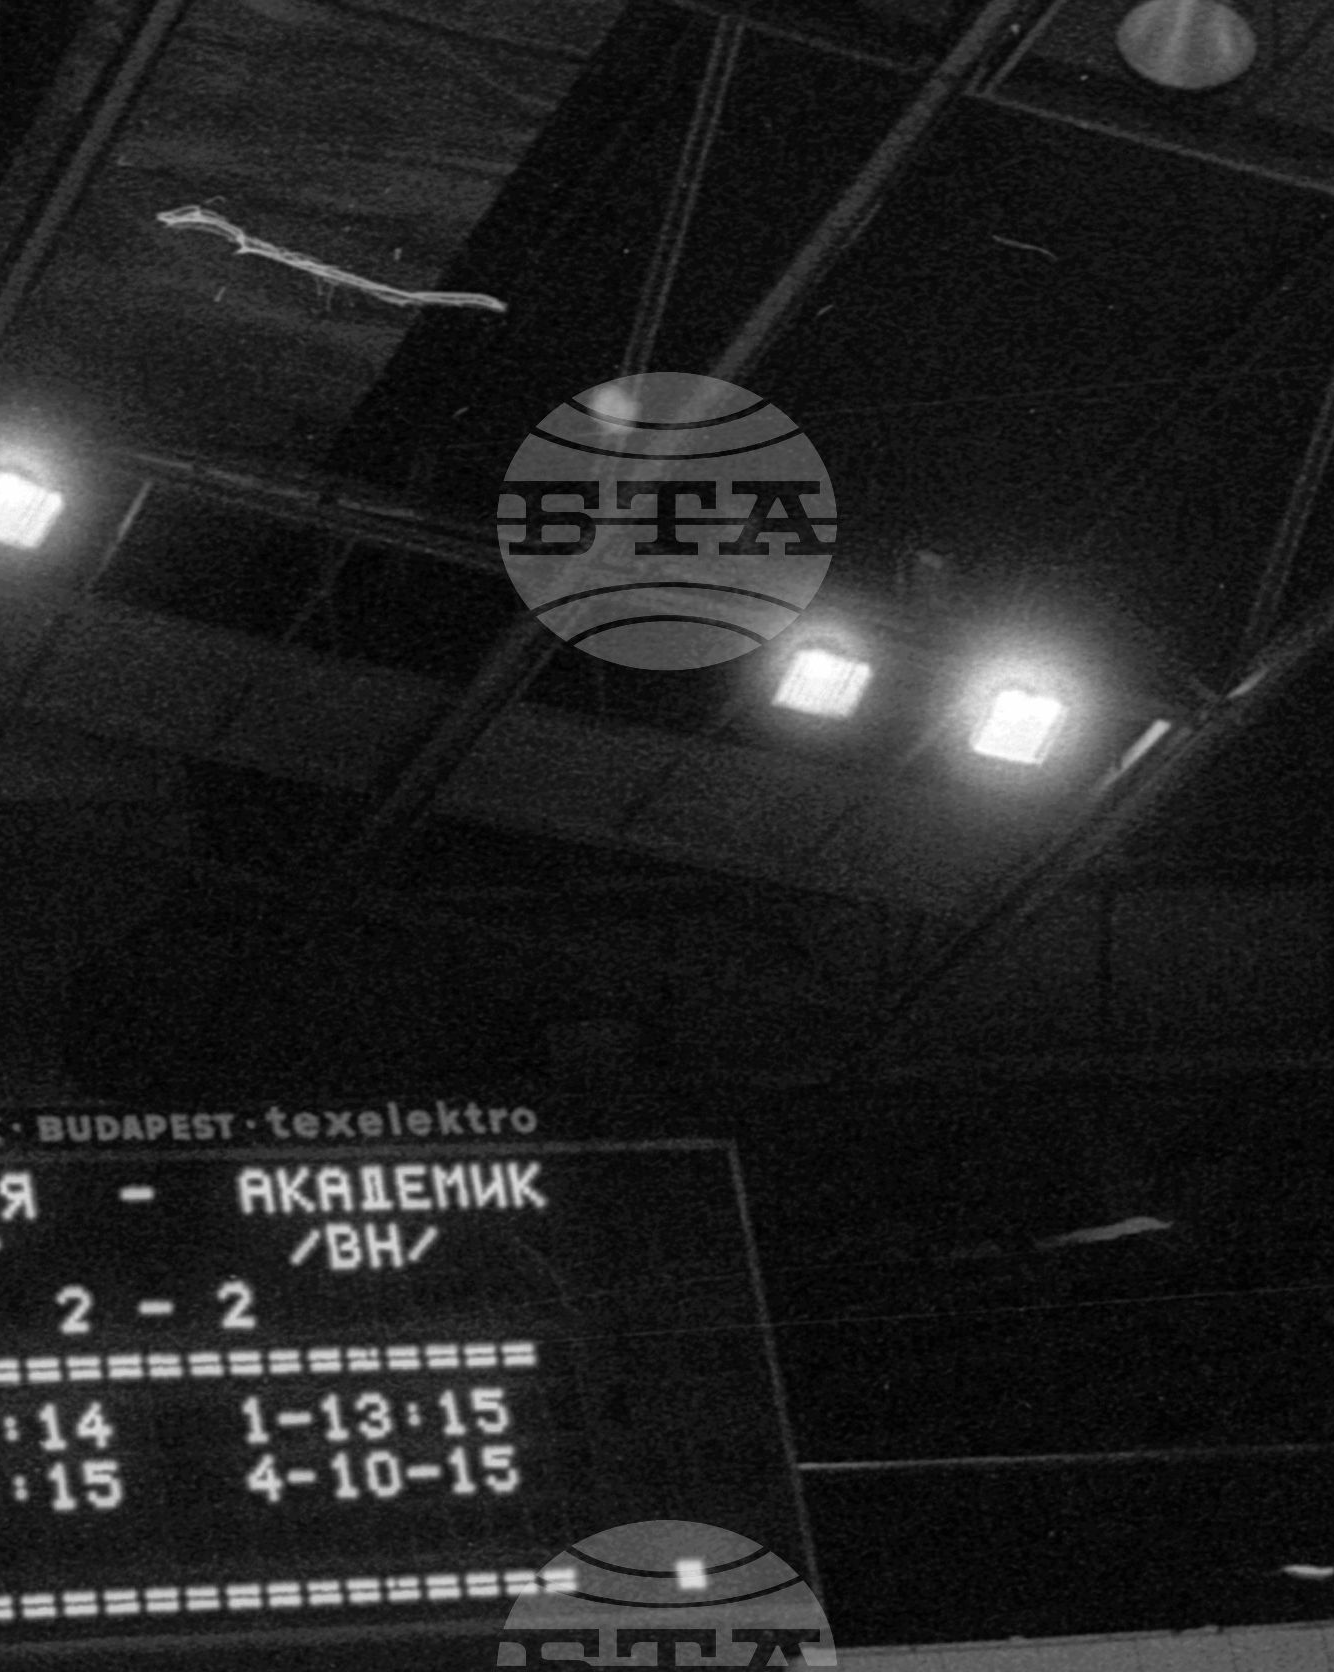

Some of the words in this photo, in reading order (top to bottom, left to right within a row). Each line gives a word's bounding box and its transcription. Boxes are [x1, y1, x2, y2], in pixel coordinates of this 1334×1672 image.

[36, 1112, 235, 1143] BUDAPEST
[264, 1099, 538, 1140] texelektro
[236, 1161, 547, 1215] АКАДЕМИК
[290, 1221, 439, 1271] /ВН/
[55, 1285, 93, 1335] 2
[216, 1279, 257, 1330] 2
[241, 1386, 511, 1445] 1-13:15
[246, 1444, 520, 1503] 4-10-15
